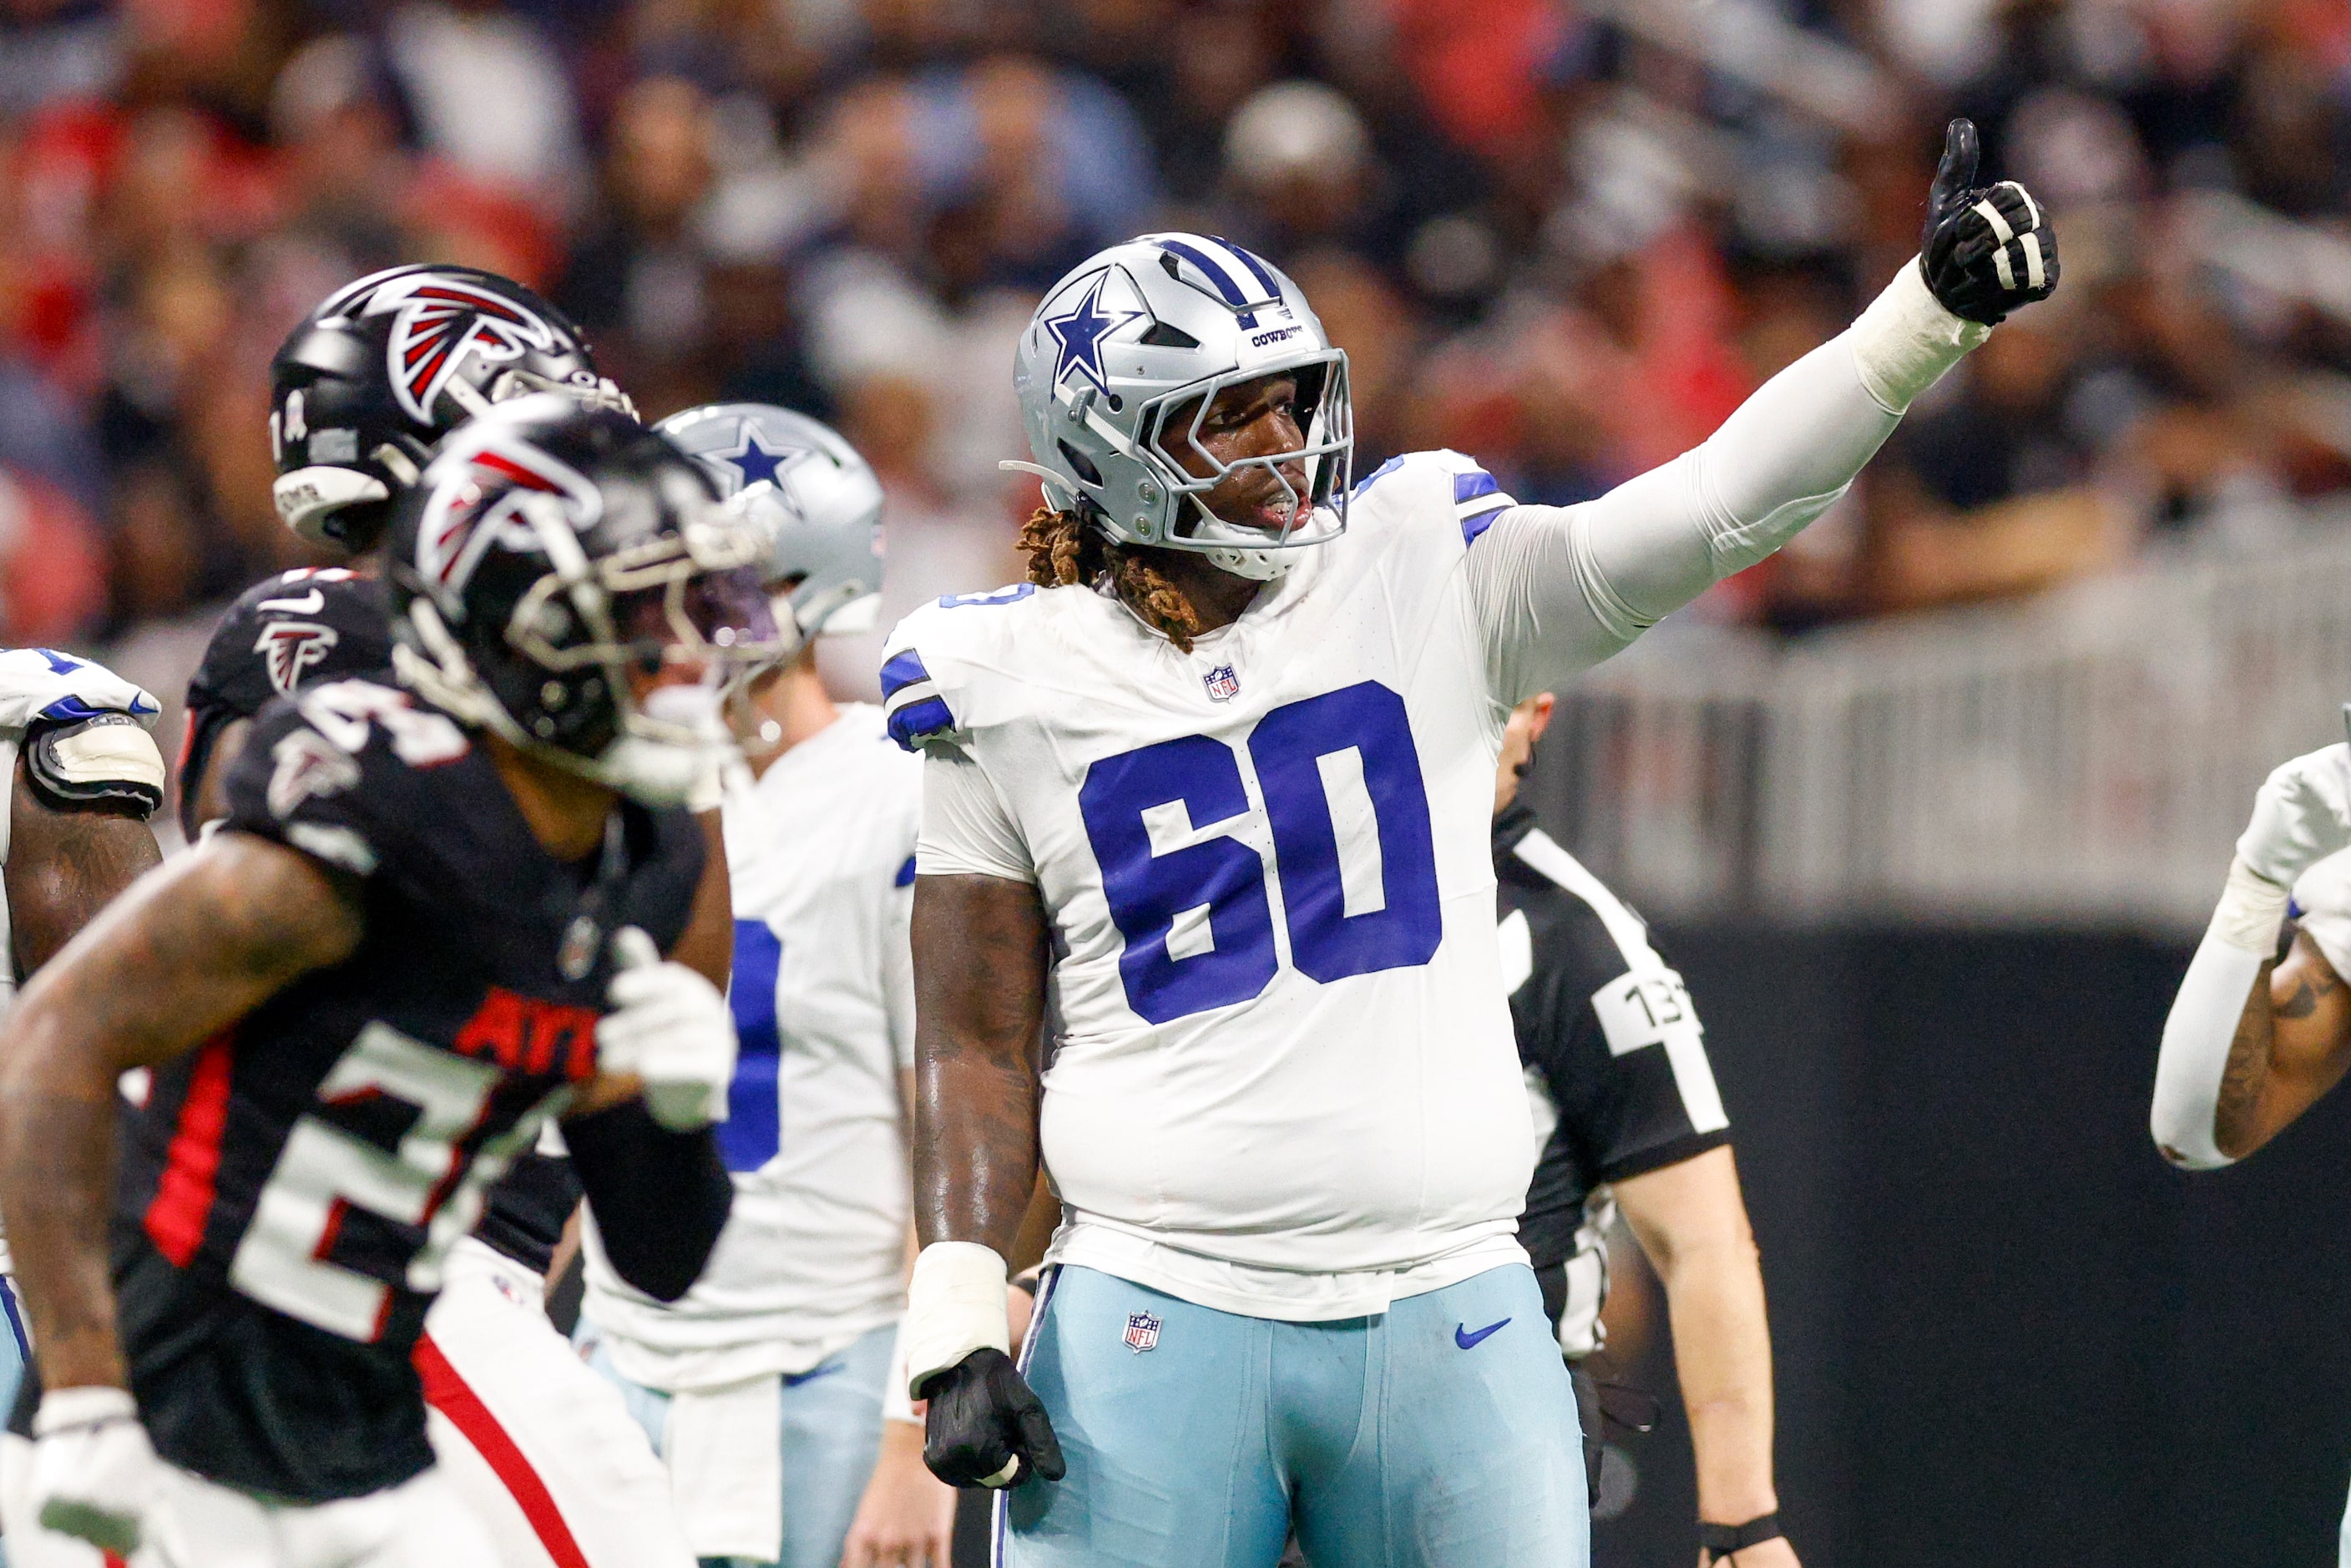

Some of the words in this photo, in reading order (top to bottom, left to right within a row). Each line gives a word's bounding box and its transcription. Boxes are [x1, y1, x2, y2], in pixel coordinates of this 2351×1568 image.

[1211, 679, 1236, 696] NFL
[1079, 680, 1443, 1025] 60
[1129, 1328, 1151, 1345] NFL
